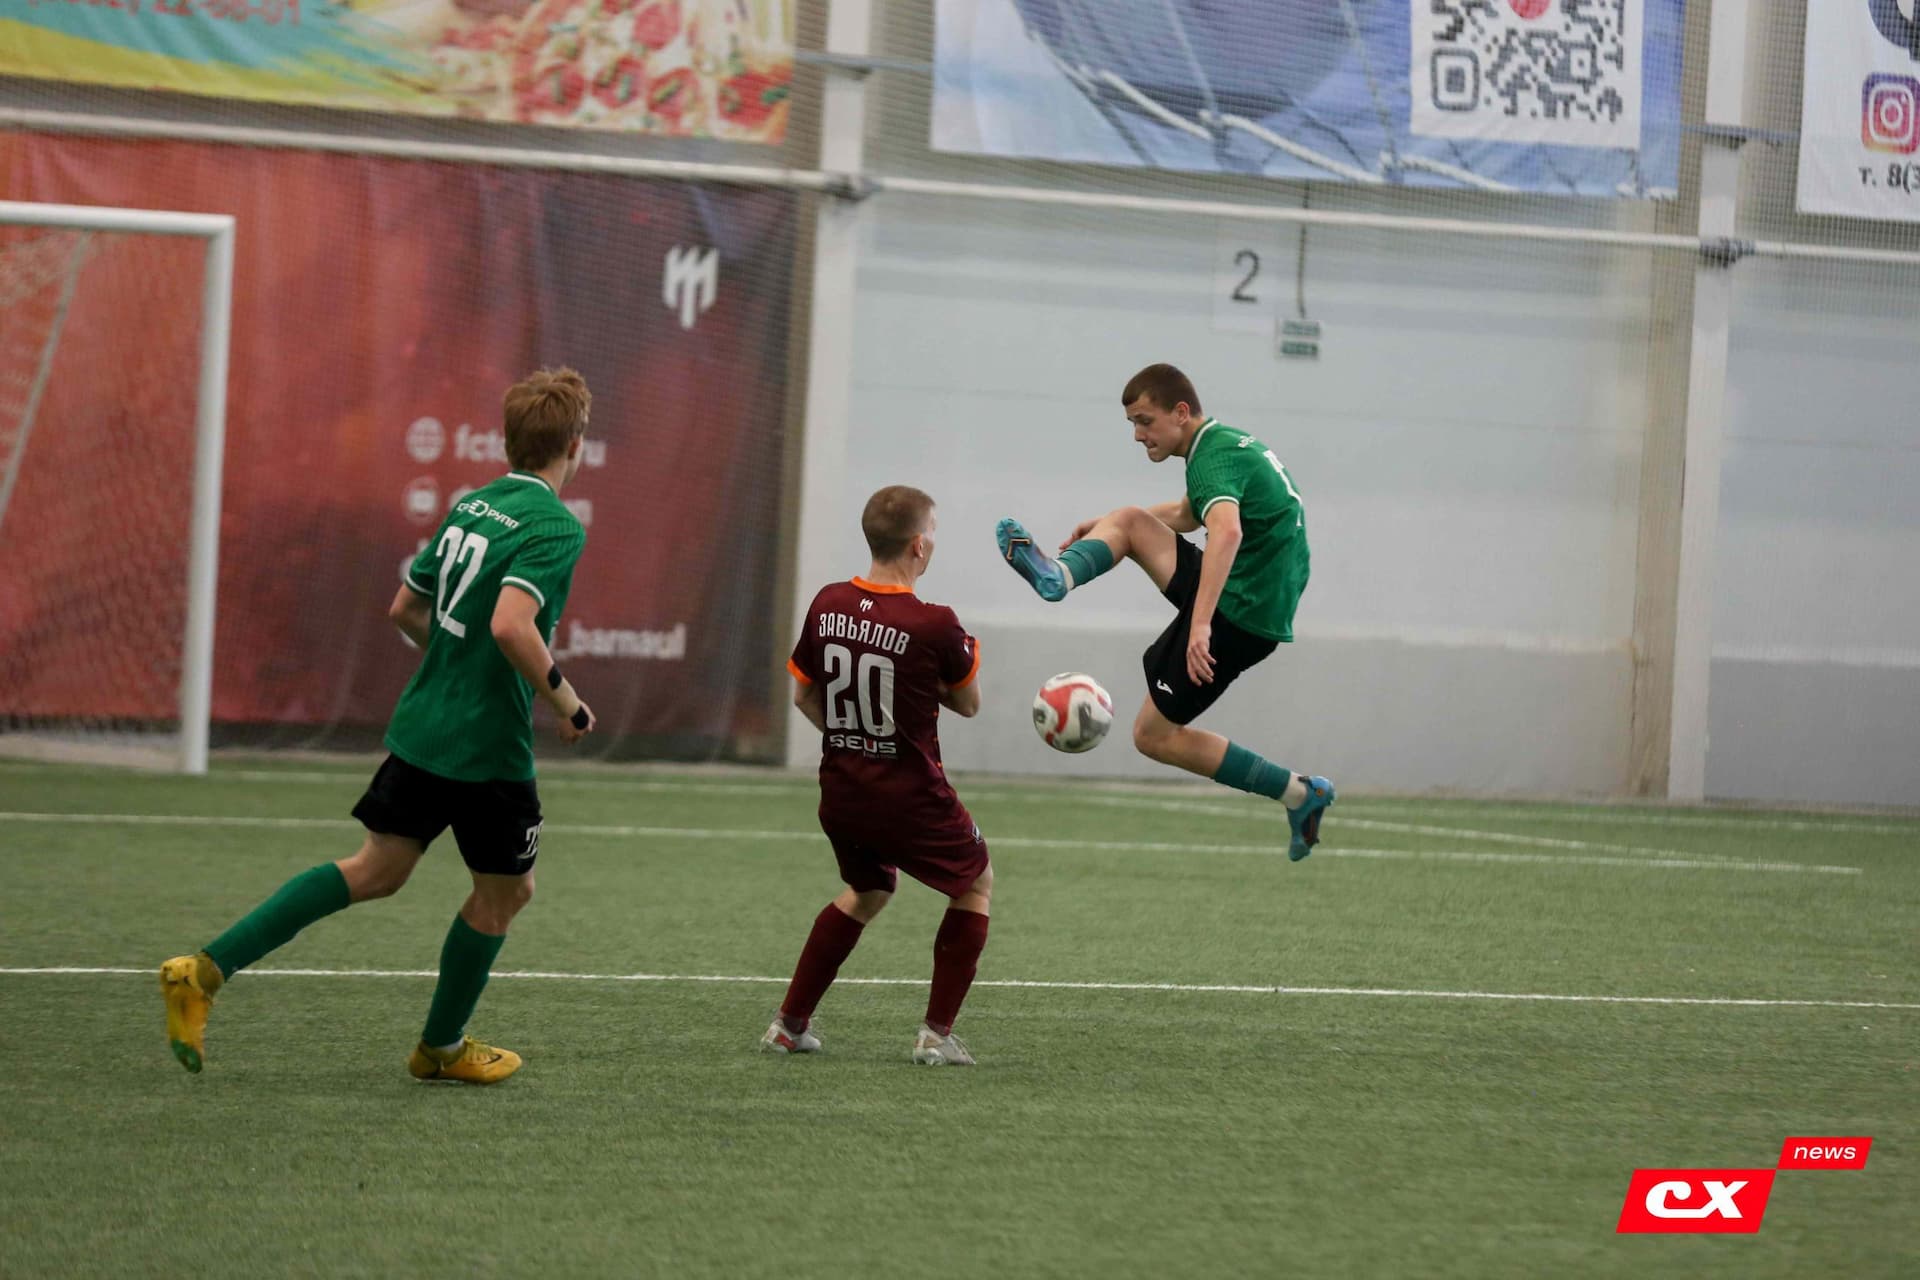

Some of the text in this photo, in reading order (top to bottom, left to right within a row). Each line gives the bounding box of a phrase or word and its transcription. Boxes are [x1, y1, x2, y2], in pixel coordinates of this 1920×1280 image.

[1232, 249, 1259, 303] 2
[435, 526, 489, 638] 22
[819, 613, 910, 656] ЗАВЬЯЛОВ
[824, 643, 897, 737] 20
[829, 734, 897, 754] SEUS
